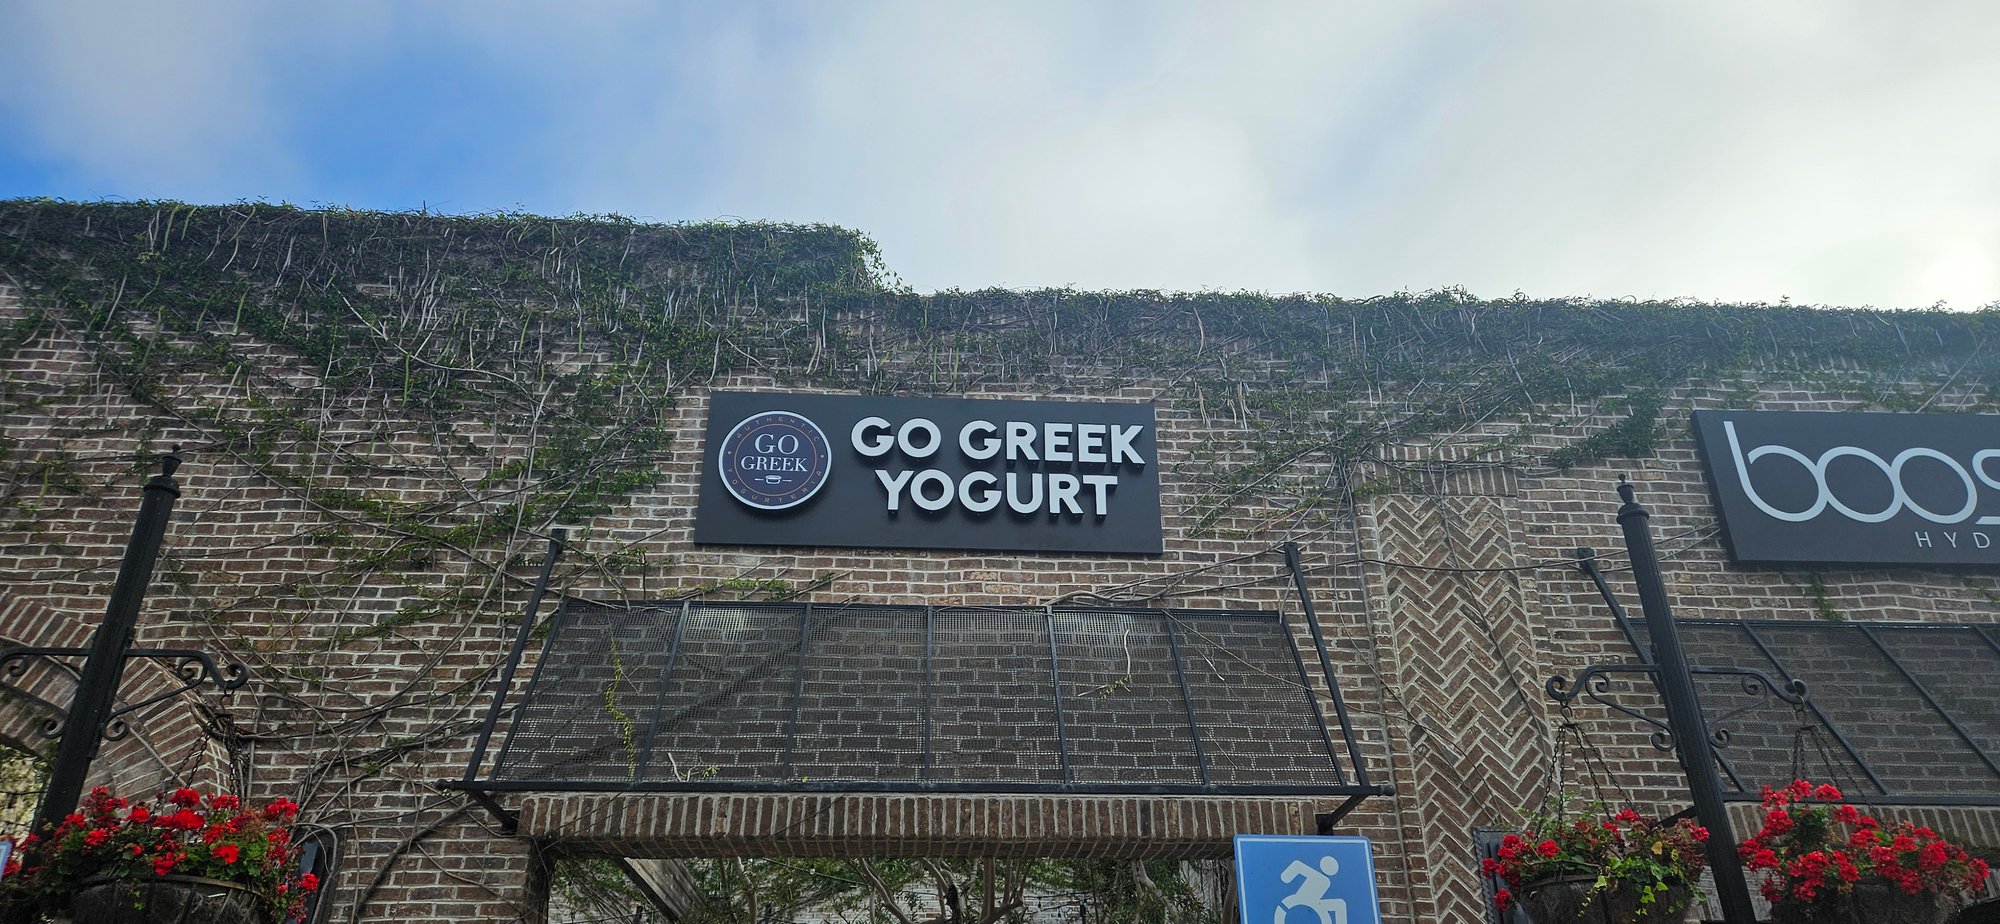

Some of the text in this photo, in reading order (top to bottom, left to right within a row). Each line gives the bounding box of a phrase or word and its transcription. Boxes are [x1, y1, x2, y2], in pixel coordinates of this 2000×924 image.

[736, 416, 820, 442] AUTHENTIC
[850, 416, 1146, 465] GO GREEK
[754, 433, 800, 455] GO
[740, 455, 808, 472] GREEK
[875, 469, 1119, 517] YOGURT
